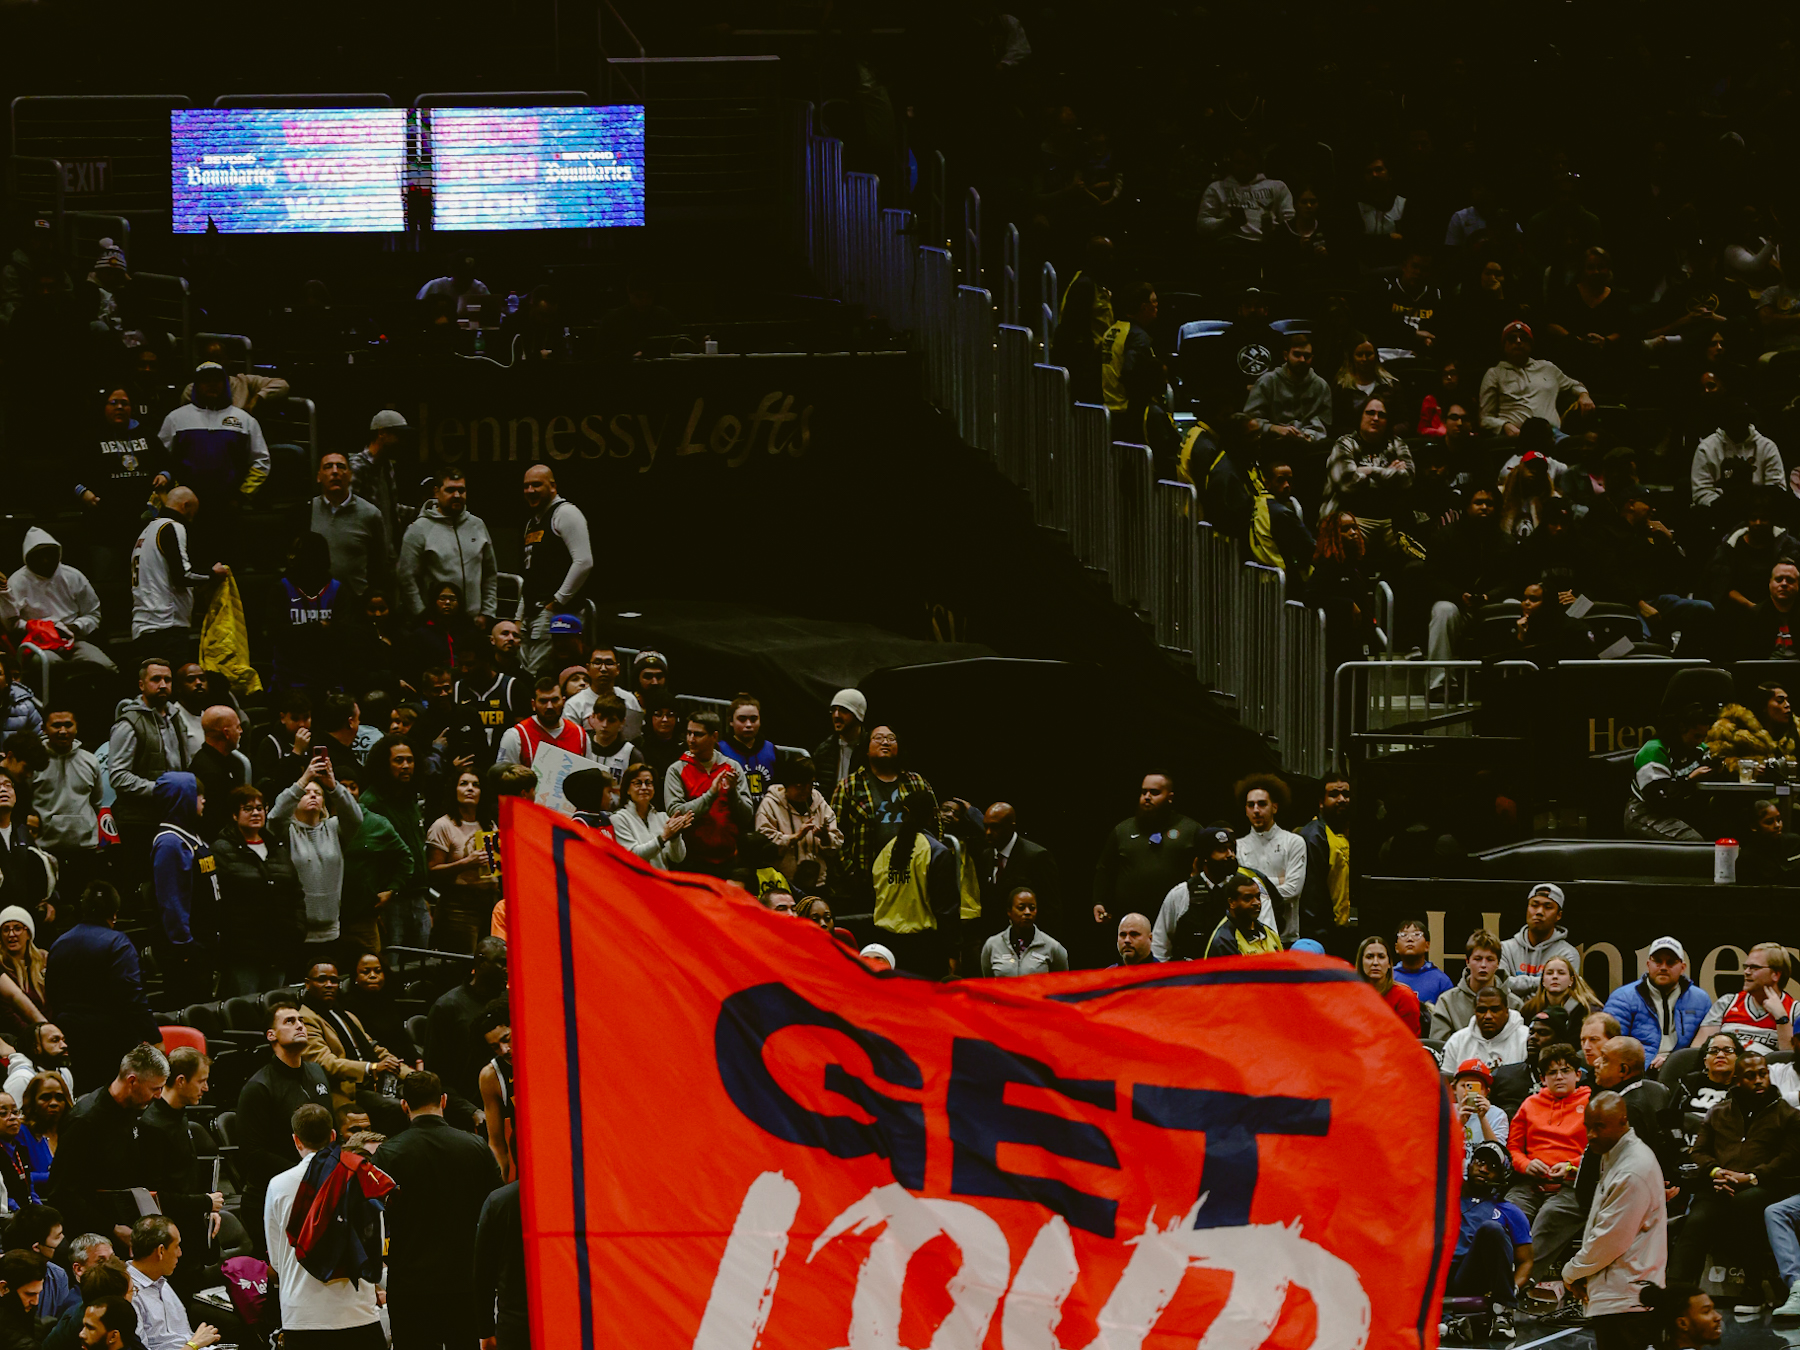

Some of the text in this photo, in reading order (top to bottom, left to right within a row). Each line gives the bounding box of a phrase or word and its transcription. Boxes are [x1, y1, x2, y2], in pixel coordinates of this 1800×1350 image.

[63, 161, 107, 192] EXIT
[187, 166, 276, 187] Boundaries
[545, 160, 632, 184] Boundaries
[676, 391, 814, 468] Lofts
[100, 437, 149, 454] DENVER
[478, 711, 504, 725] VER
[714, 981, 1332, 1239] GET
